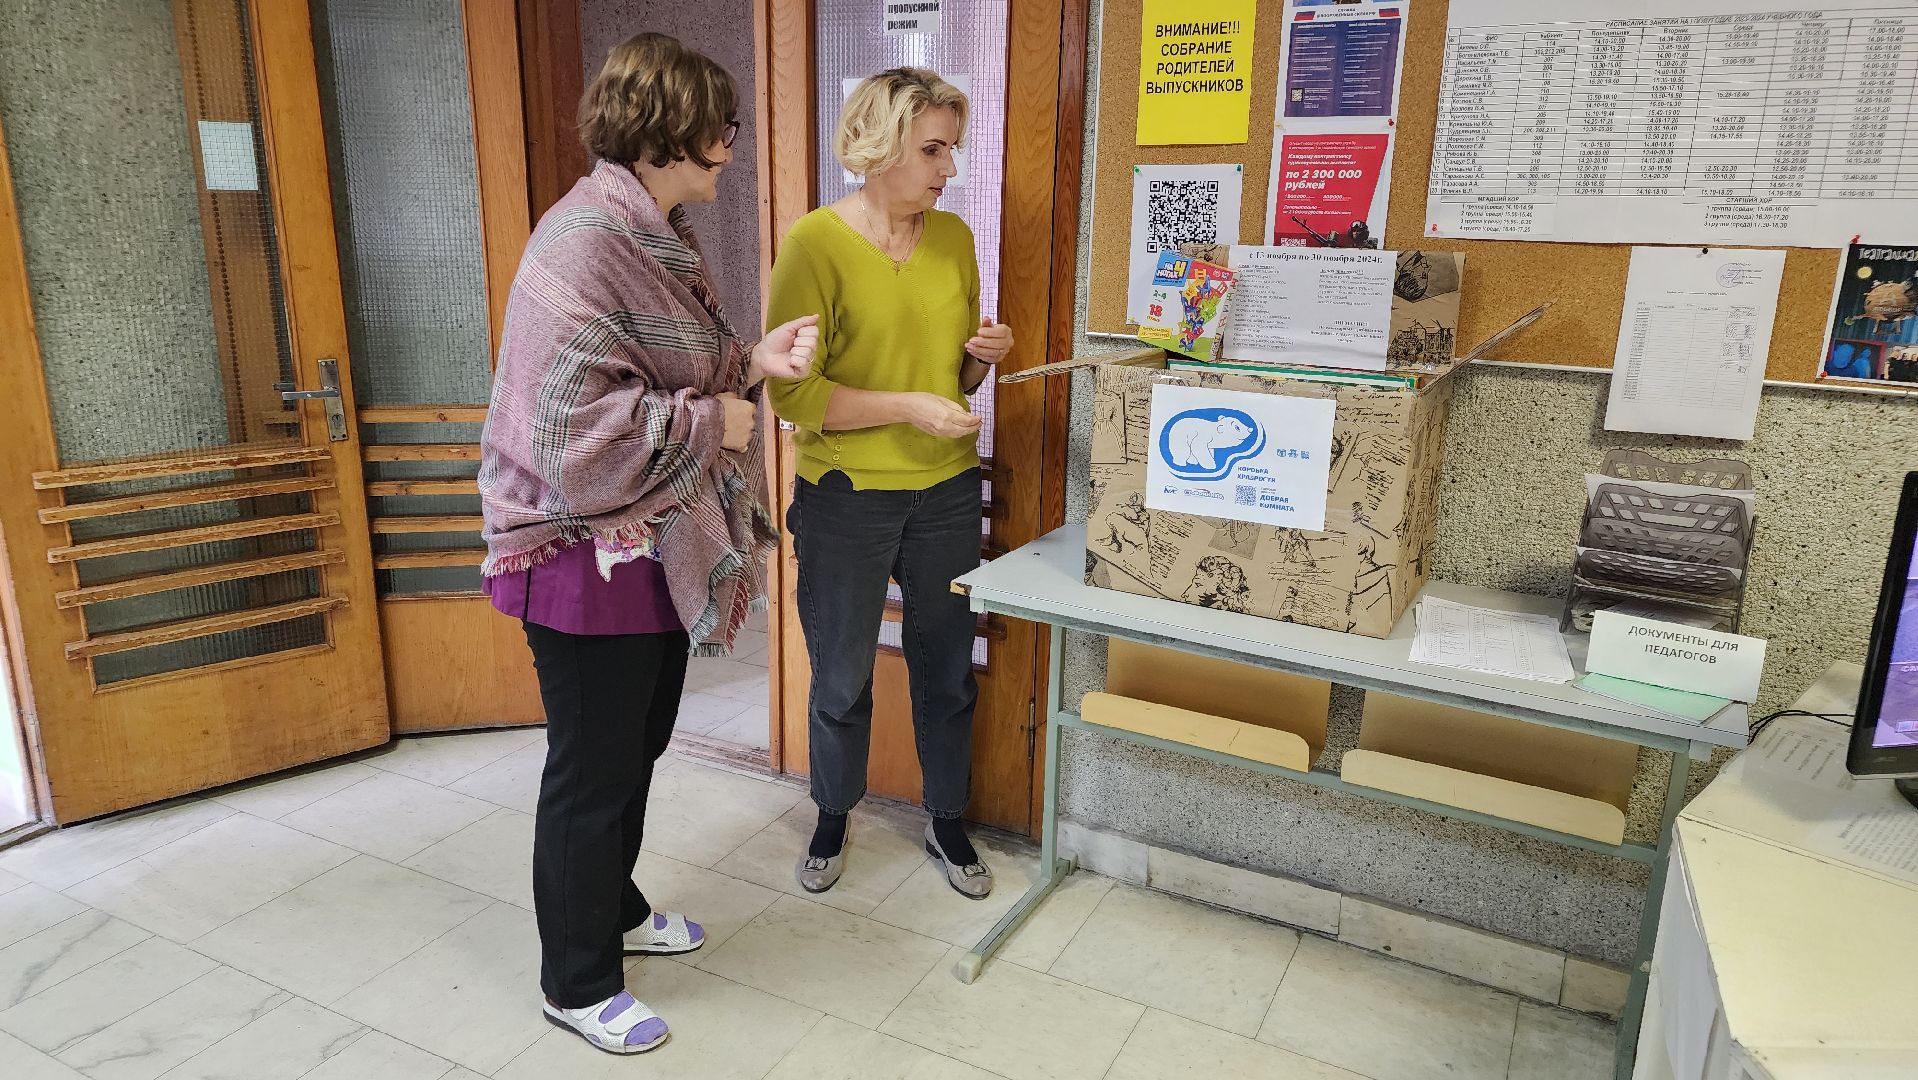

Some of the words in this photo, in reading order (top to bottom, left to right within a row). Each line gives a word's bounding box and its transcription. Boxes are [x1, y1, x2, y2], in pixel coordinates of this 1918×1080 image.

[888, 0, 940, 14] пропускной
[888, 20, 917, 30] режим
[1156, 21, 1240, 37] ВНИМАНИЕ!!!
[1161, 41, 1232, 56] СОБРАНИЕ
[1157, 57, 1234, 77] РОДИТЕЛЕЙ
[1146, 79, 1243, 94] ВЫПУСКНИКОВ
[1285, 171, 1299, 179] по
[1302, 169, 1310, 179] 2
[1311, 169, 1335, 179] 300
[1338, 169, 1363, 179] 000
[1285, 180, 1326, 191] рублей
[1267, 253, 1297, 262] ноября
[1311, 253, 1322, 261] 30
[1323, 254, 1354, 264] ноября
[1259, 502, 1295, 513] КОМНАТА
[1628, 625, 1708, 647] ДОКУМЕНТЫ
[1711, 639, 1739, 651] ДЛЯ
[1645, 644, 1717, 664] ПЕДАГОГОВ
